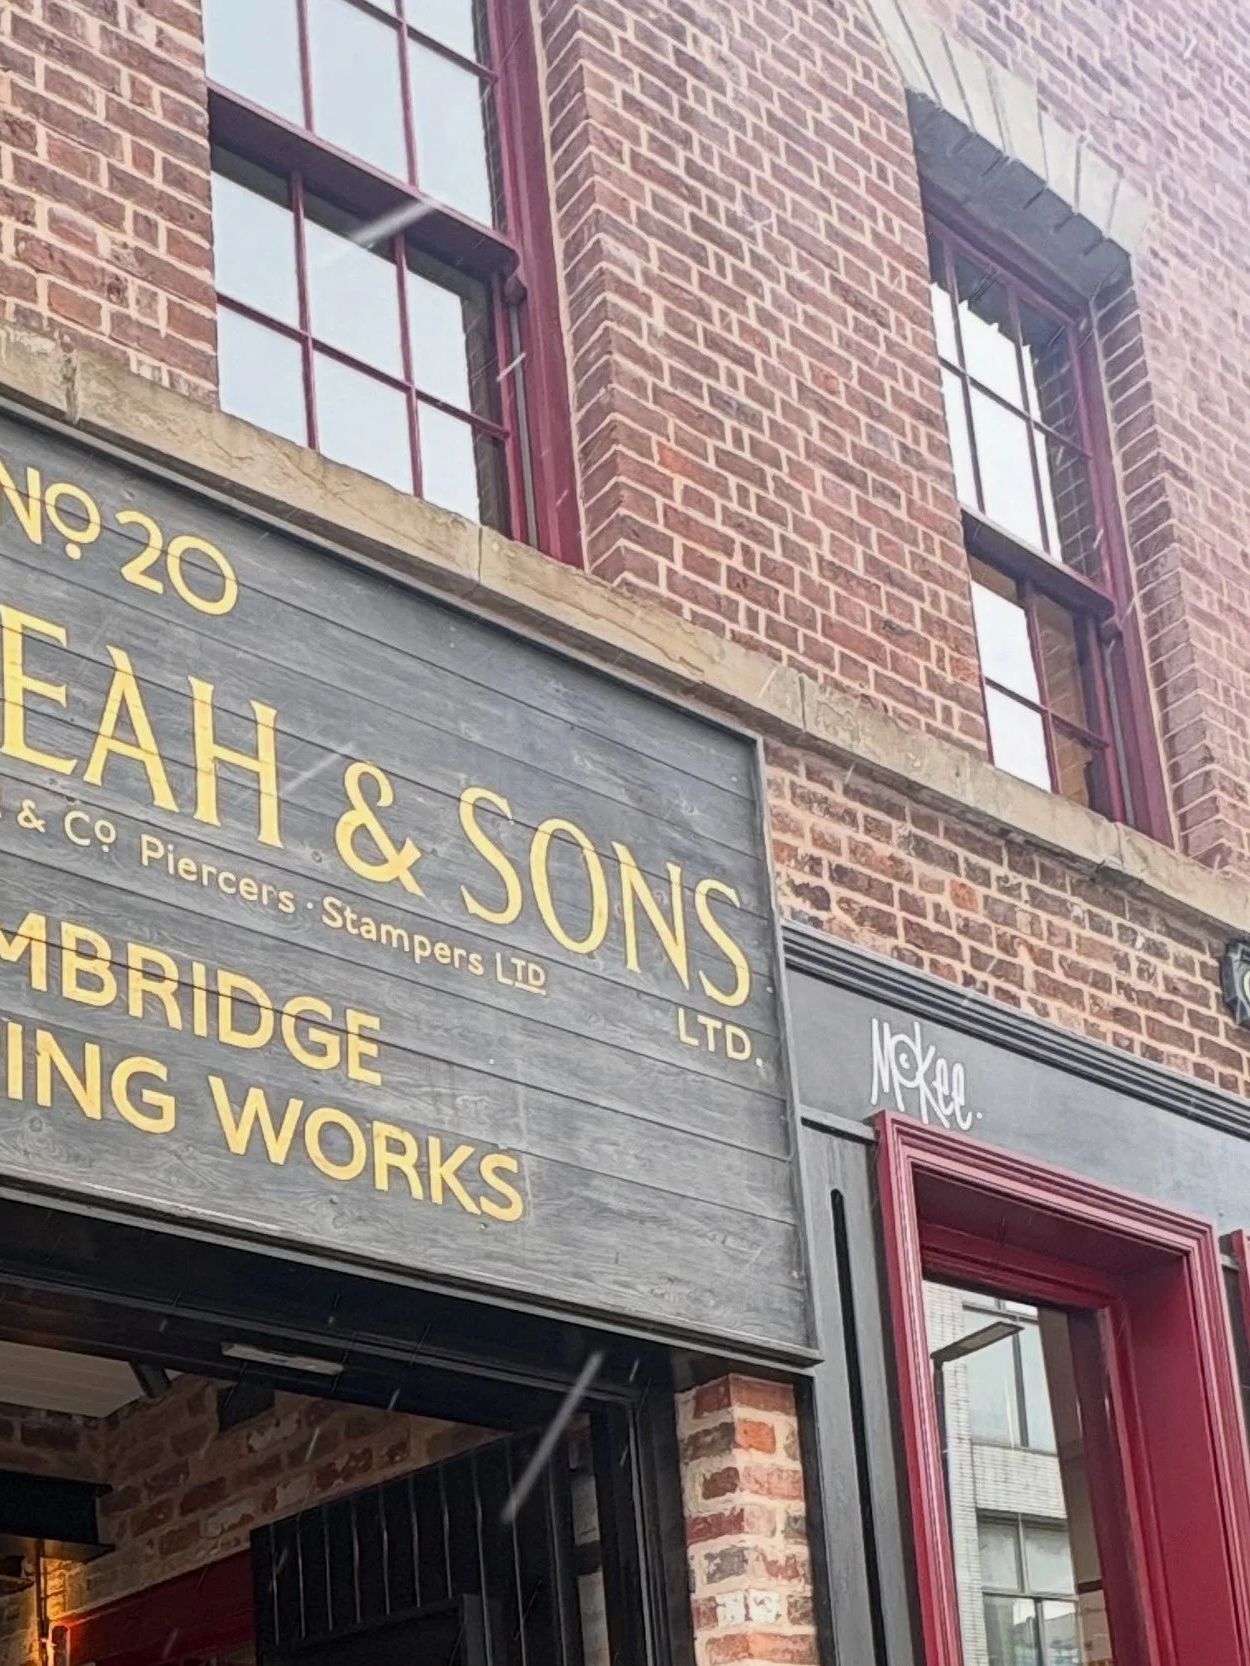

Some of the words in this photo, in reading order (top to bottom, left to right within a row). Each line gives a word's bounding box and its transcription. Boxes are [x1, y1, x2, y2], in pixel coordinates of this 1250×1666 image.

[116, 509, 240, 617] 20
[16, 799, 47, 833] &
[139, 835, 296, 914] Piercers
[321, 897, 483, 977] Stampers
[334, 761, 427, 899] &
[458, 786, 752, 1008] SONS
[207, 1076, 525, 1224] WORKS
